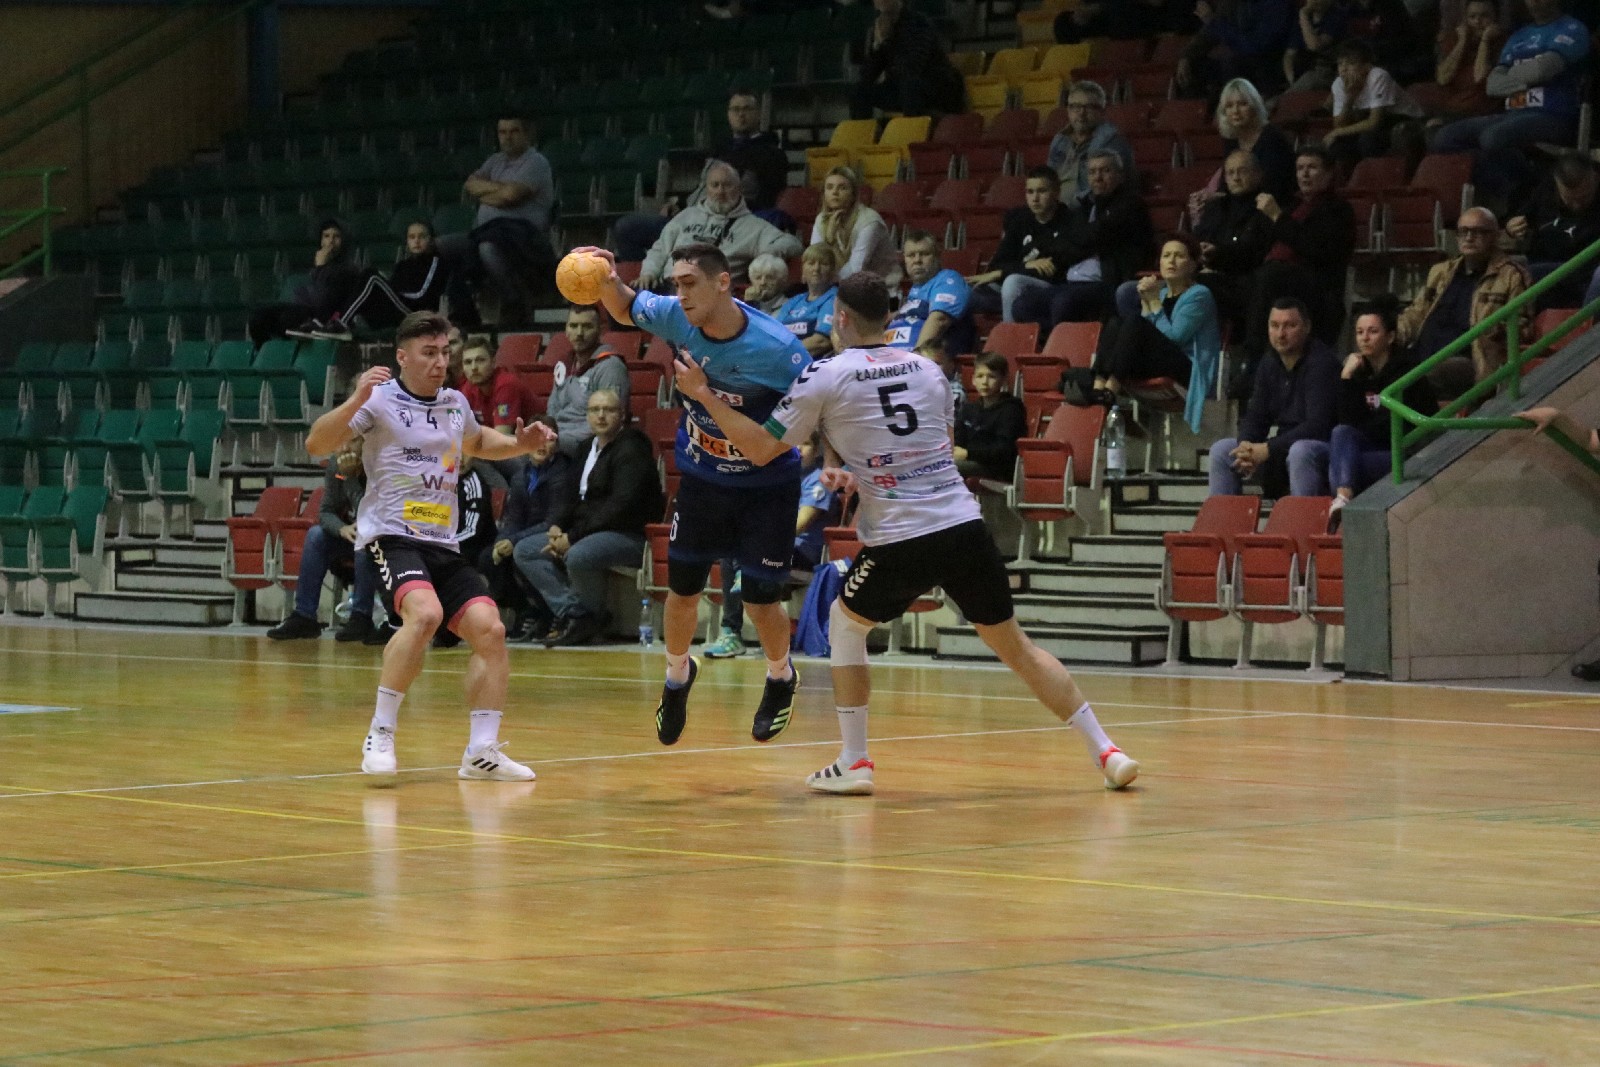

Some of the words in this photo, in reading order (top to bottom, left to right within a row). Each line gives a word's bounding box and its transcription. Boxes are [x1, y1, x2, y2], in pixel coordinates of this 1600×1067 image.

[855, 360, 923, 382] ŁAZARCZYK
[426, 408, 438, 429] 4
[877, 382, 918, 436] 5
